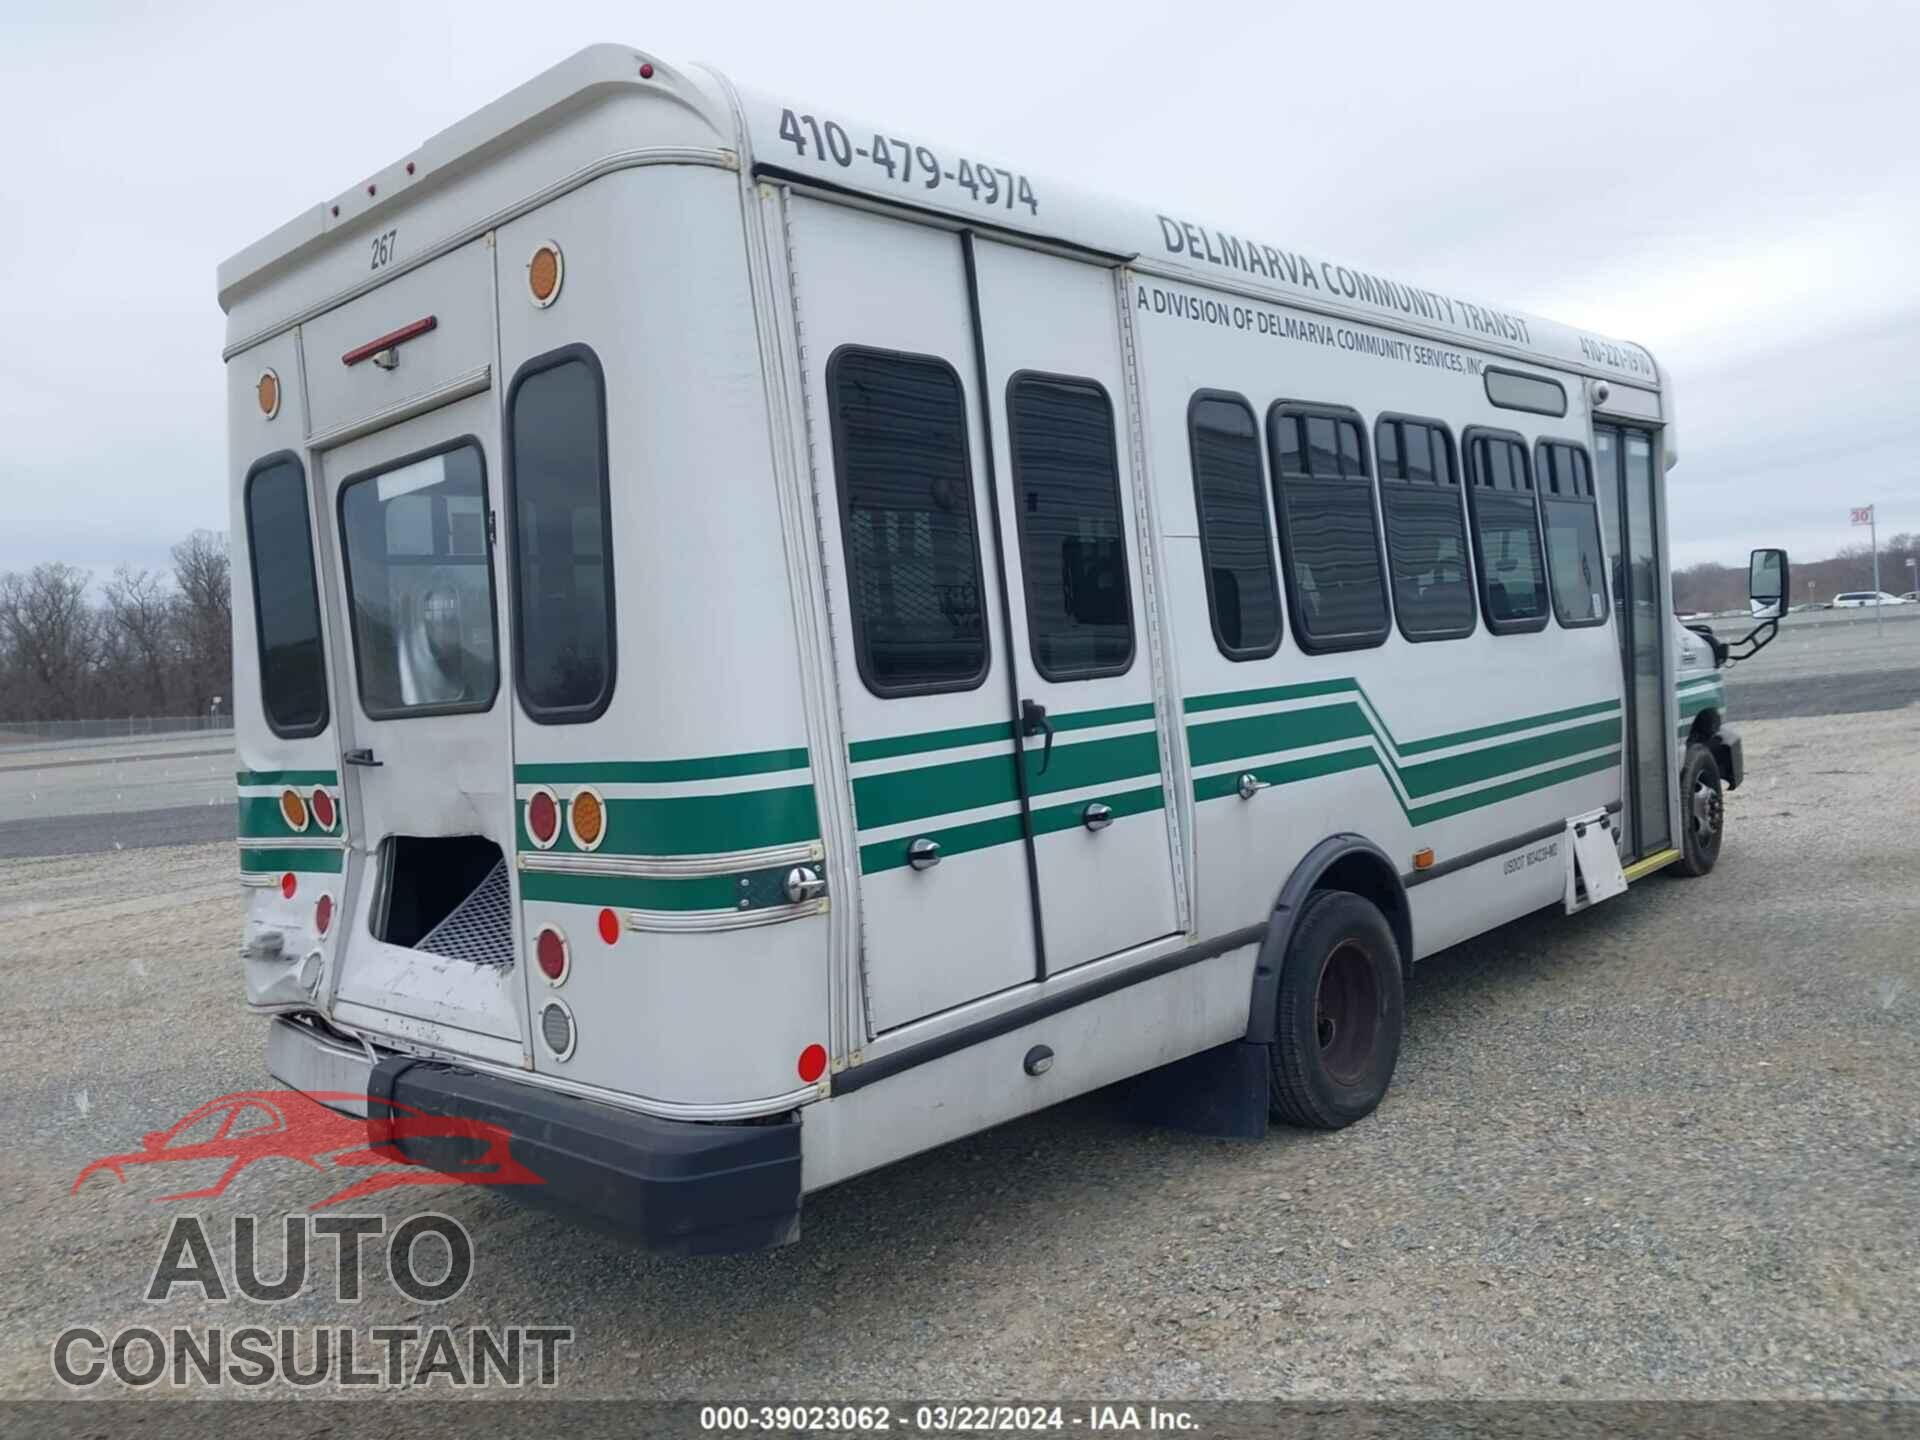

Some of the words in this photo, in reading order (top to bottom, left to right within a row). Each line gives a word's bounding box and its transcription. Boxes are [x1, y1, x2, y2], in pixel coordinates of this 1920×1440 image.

[779, 107, 1038, 216] 410-479-4974
[371, 229, 397, 270] 267
[1156, 213, 1320, 290] DELMARVA
[1321, 261, 1456, 324] COMMUNITY
[1456, 299, 1531, 345] TRANSIT
[1137, 286, 1150, 311] A
[1153, 289, 1231, 327] DIVISION
[1234, 306, 1254, 330] OF
[1257, 311, 1336, 347] DELMARVA
[1337, 328, 1412, 362] COMMUNITY
